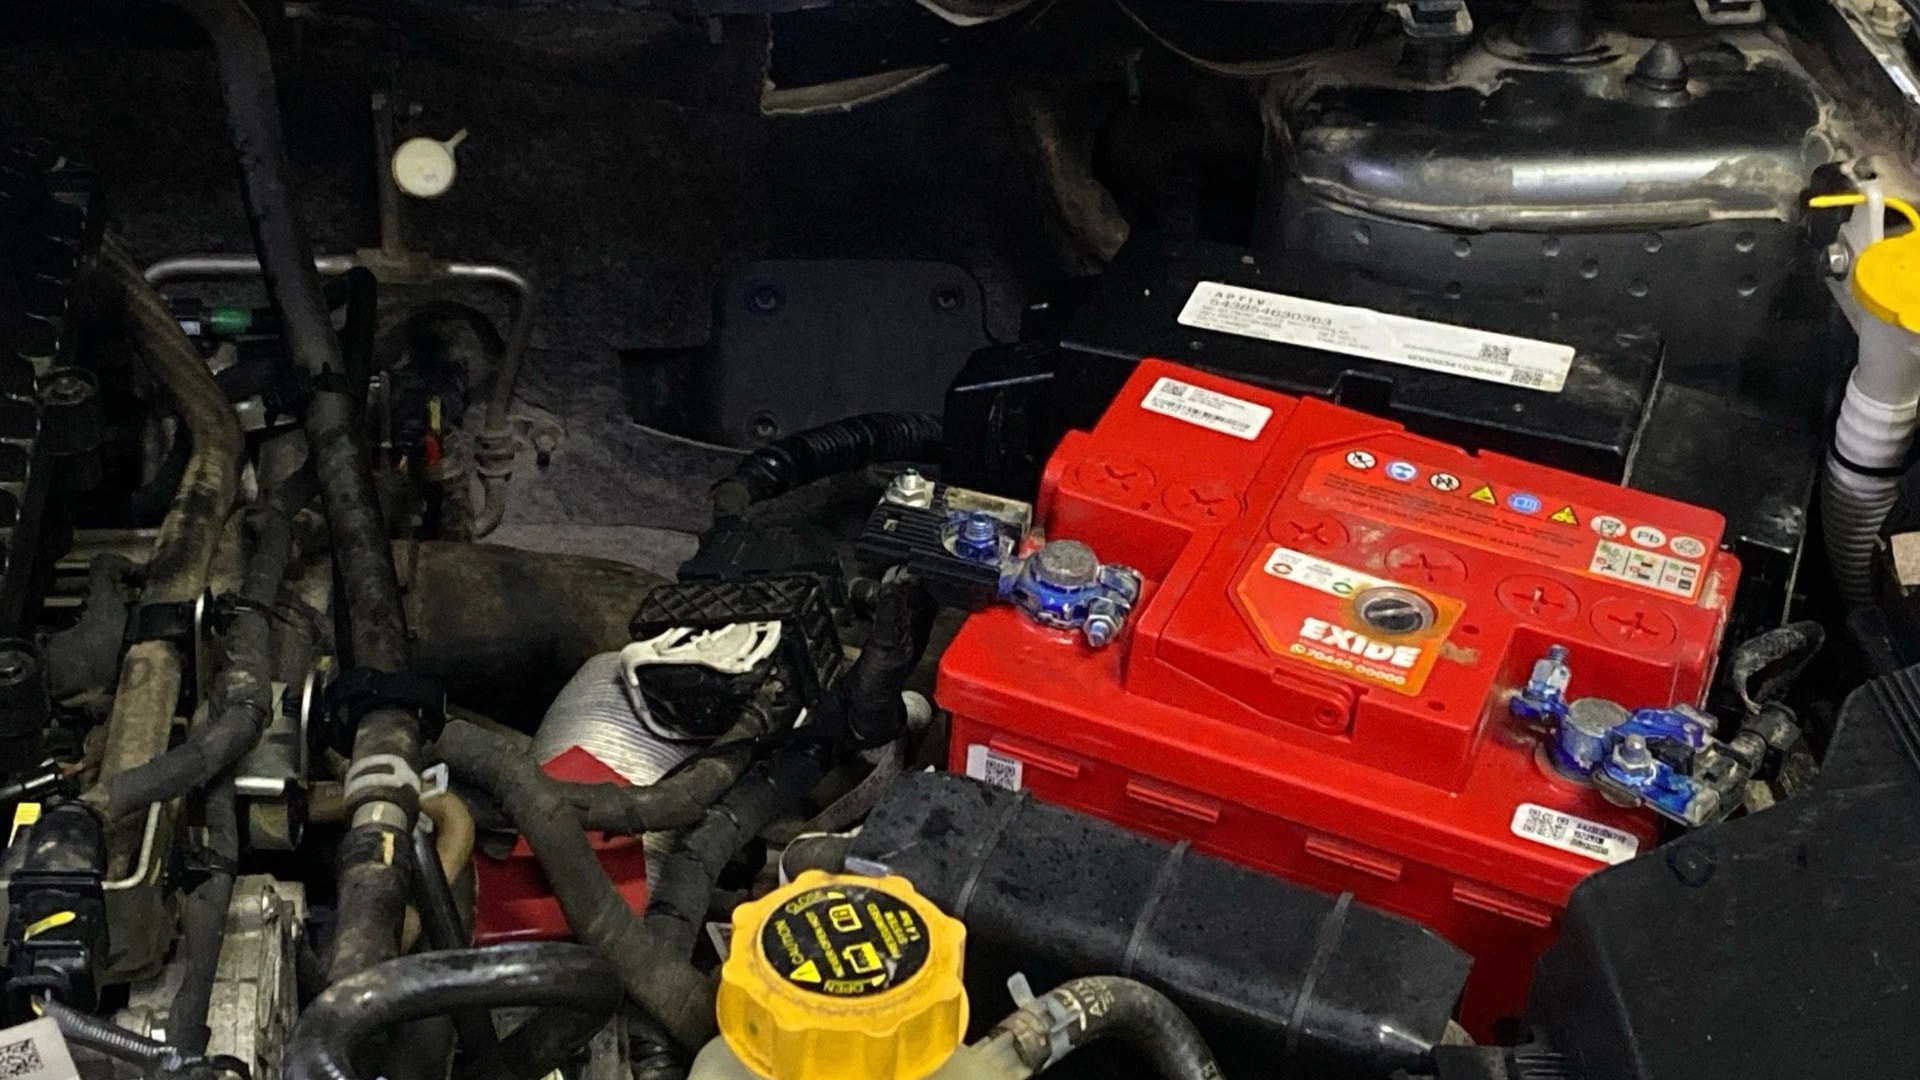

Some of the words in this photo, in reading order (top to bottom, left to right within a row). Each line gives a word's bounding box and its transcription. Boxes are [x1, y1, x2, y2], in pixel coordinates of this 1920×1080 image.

[1637, 531, 1660, 544] Pb
[1300, 617, 1422, 668] EXIDE
[1355, 664, 1406, 685] 00000
[775, 918, 804, 965] CAUTION
[823, 979, 865, 994] OPEN
